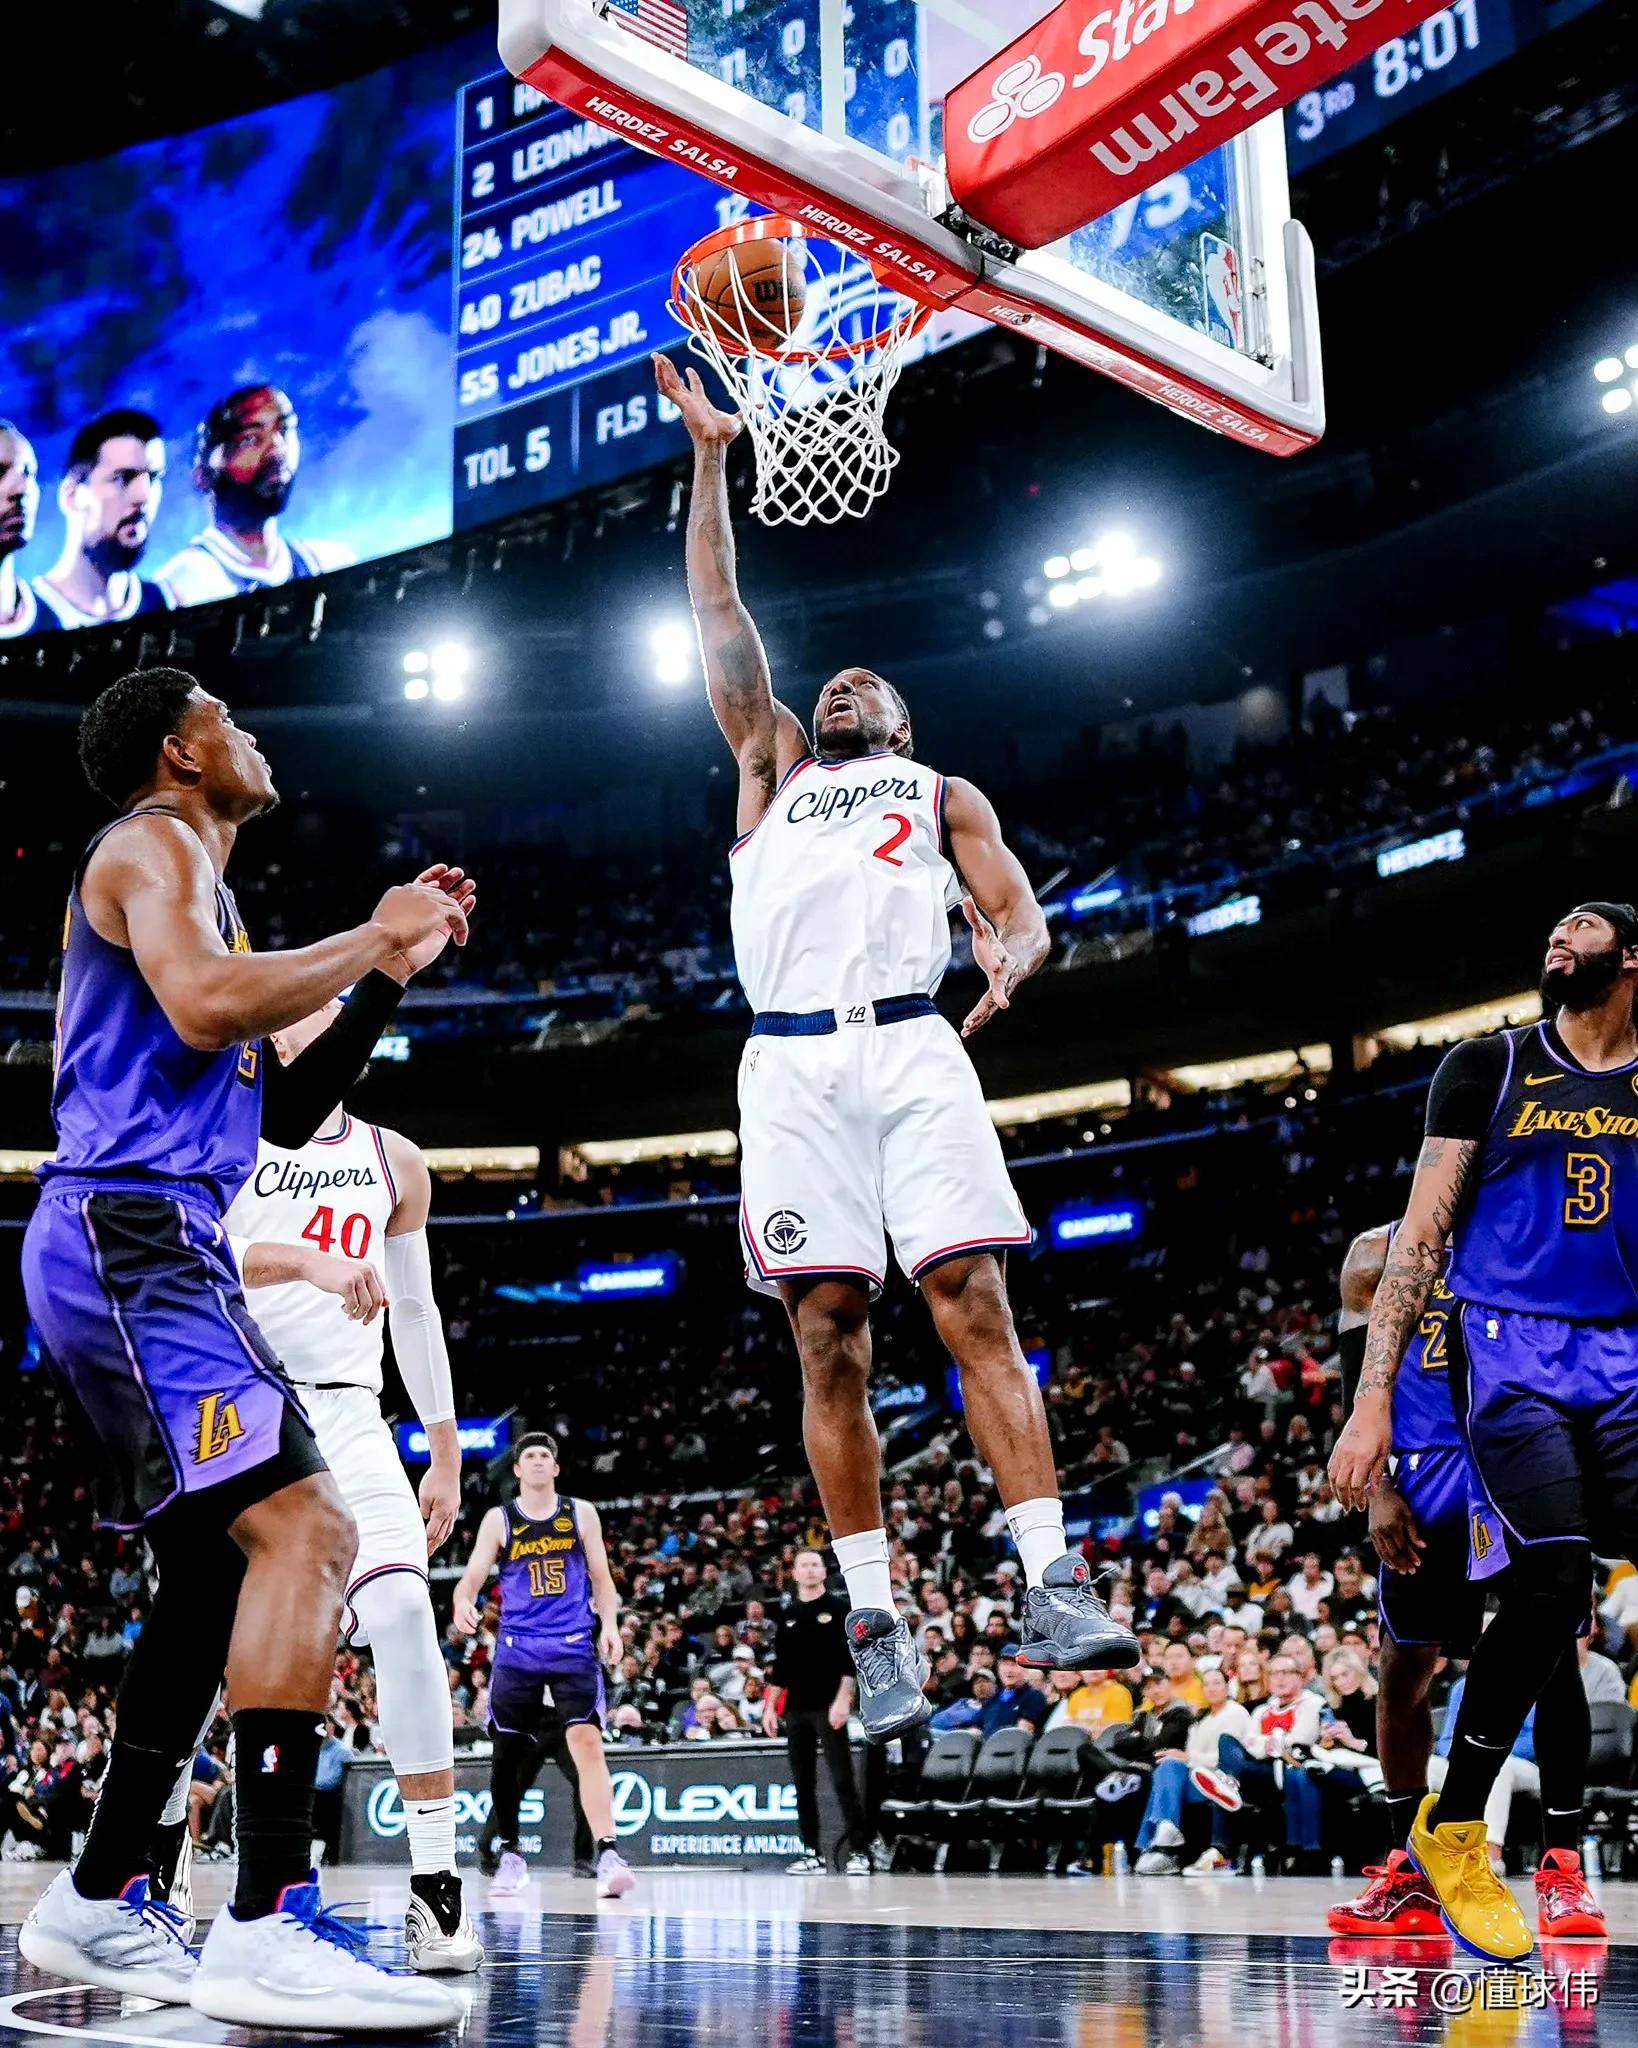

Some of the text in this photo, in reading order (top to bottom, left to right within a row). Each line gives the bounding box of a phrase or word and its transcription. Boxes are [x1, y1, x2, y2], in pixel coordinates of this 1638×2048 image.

[476, 96, 494, 130] 1
[585, 96, 669, 144] HERDEZ
[668, 139, 740, 180] SALSA
[1090, 46, 1280, 176] Farm
[471, 161, 495, 198] 2
[462, 227, 502, 270] 24
[511, 180, 622, 250] POWELL
[799, 204, 938, 283] HERDEZ SALSA
[459, 255, 602, 335] 40 ZUBAC
[460, 310, 648, 405] 55 JONES JR.
[596, 395, 648, 445] FLS
[1158, 382, 1270, 443] HERDEZ SALSA
[464, 426, 551, 489] TOL 5
[787, 777, 923, 824] Clippers
[872, 813, 912, 867] 2
[1507, 1101, 1638, 1139] LAKESHO
[254, 1161, 377, 1199] Clippers
[1564, 1152, 1611, 1225] 3
[301, 1205, 372, 1259] 40
[189, 1392, 246, 1465] LA
[528, 1558, 567, 1597] 15
[651, 1834, 805, 1855] EXPERIENCE AMAZIN
